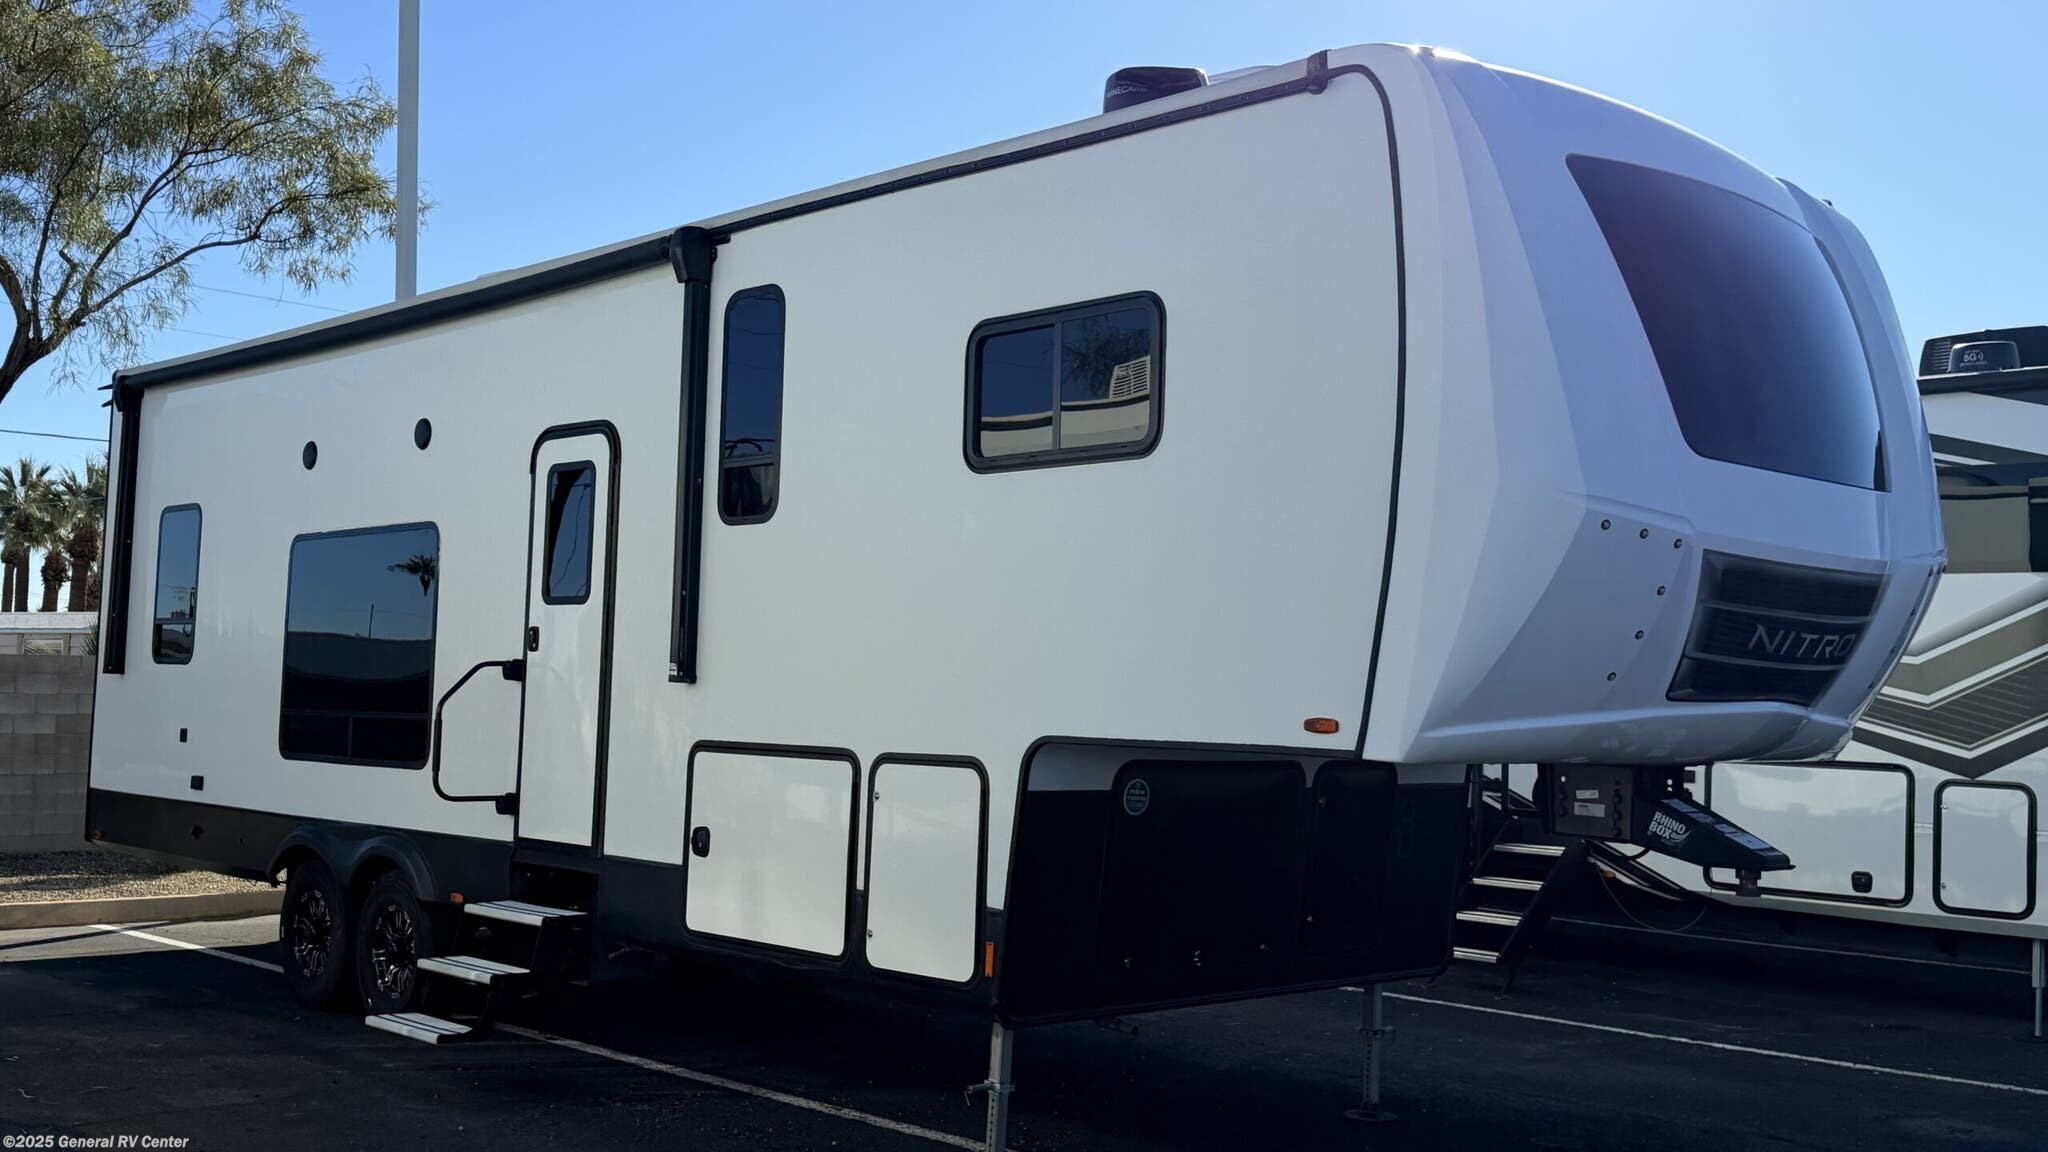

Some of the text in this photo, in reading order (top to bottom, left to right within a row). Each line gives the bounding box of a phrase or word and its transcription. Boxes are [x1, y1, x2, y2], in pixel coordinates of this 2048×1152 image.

[1748, 623, 1857, 659] NITRO
[1648, 820, 1672, 840] BOX
[1652, 811, 1686, 834] RHINO
